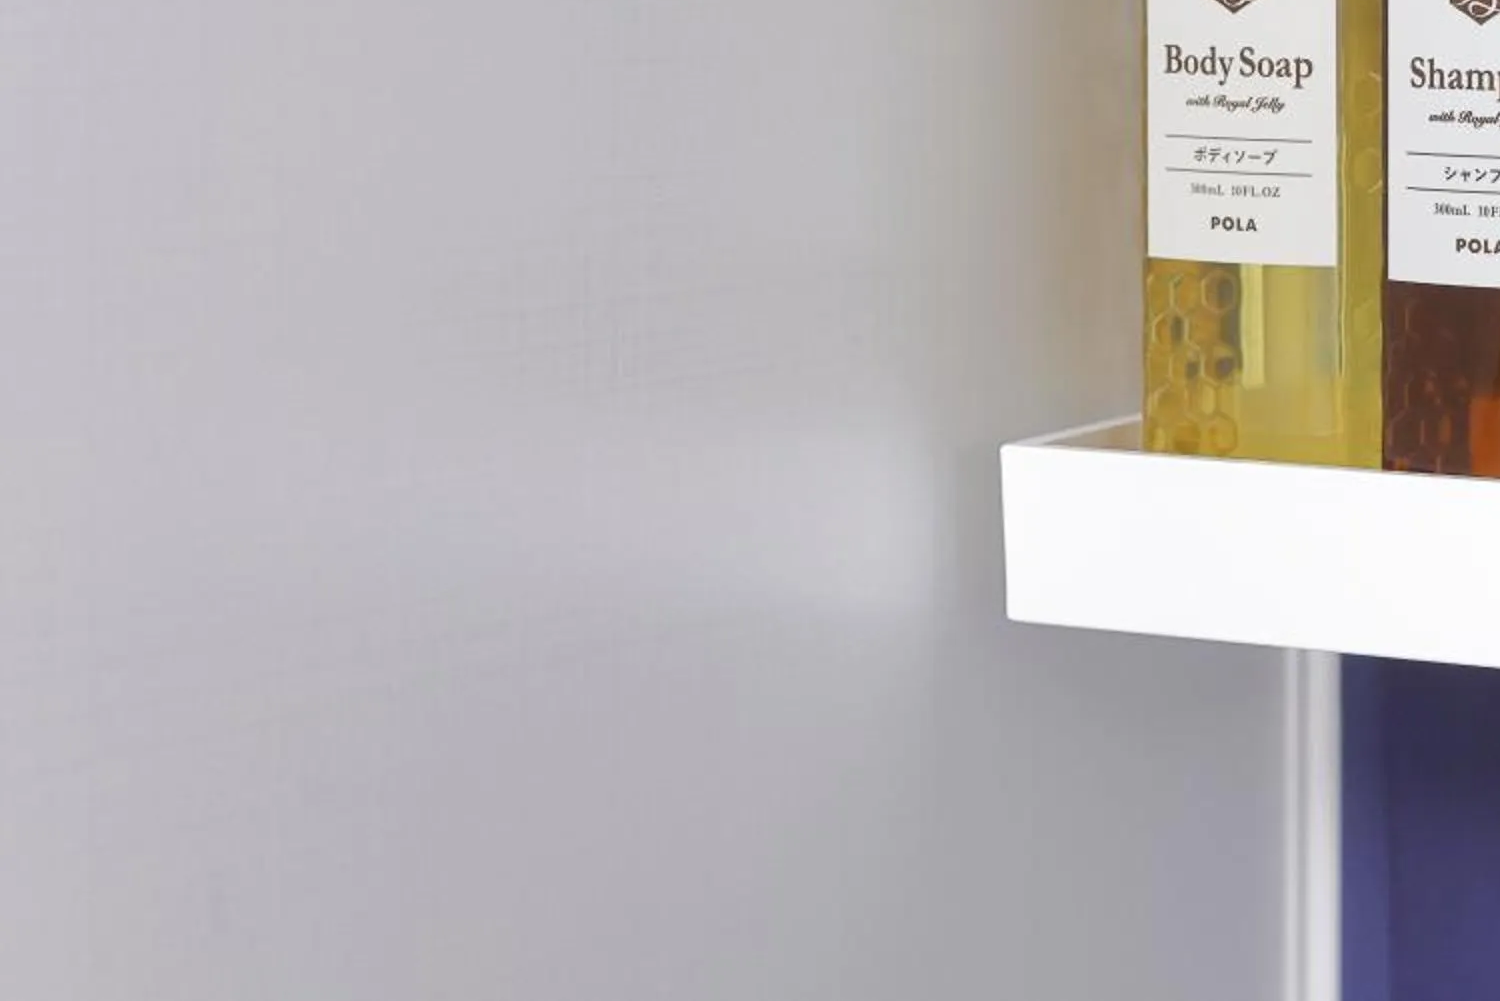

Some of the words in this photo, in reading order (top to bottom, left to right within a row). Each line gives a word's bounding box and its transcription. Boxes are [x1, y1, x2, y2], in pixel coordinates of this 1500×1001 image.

[1164, 44, 1235, 86] Body
[1238, 46, 1314, 89] Soap
[1185, 95, 1211, 107] with
[1211, 94, 1251, 113] Royal
[1251, 97, 1286, 114] Jelly
[1428, 110, 1456, 123] with
[1457, 110, 1500, 128] Royal
[1193, 145, 1279, 166] ボディソープ
[1210, 216, 1258, 232] POLA
